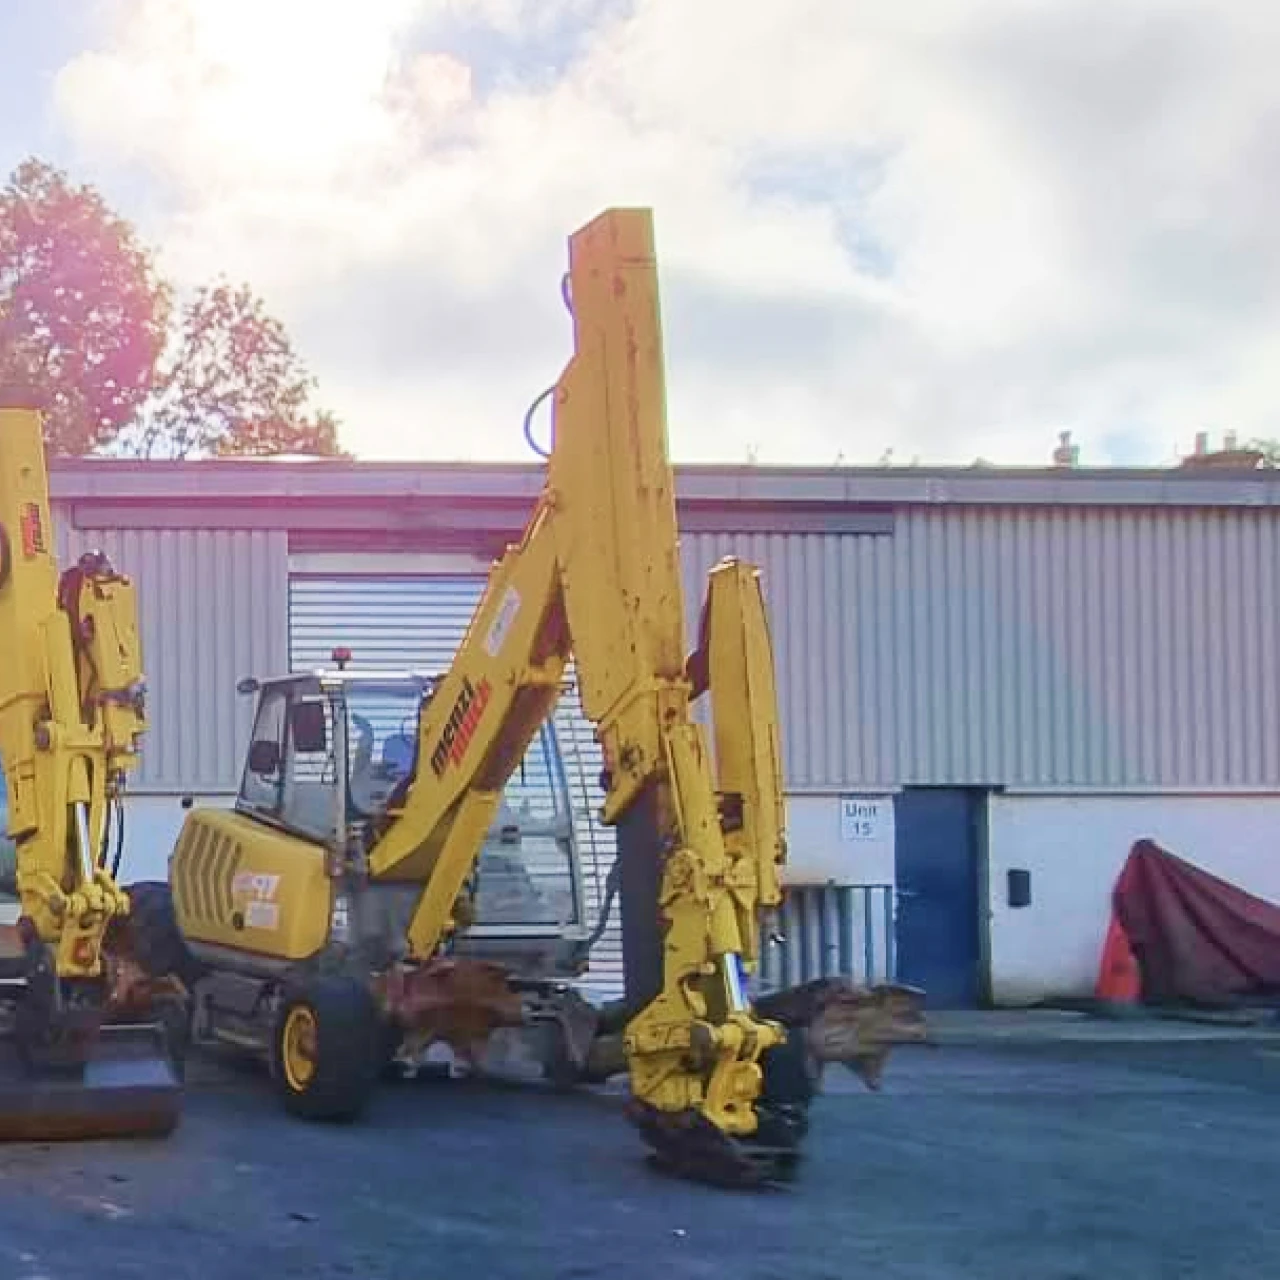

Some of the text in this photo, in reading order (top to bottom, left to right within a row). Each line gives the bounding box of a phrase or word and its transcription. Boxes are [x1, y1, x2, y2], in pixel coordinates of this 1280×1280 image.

[430, 676, 474, 777] menzi
[845, 803, 878, 818] Unit
[853, 821, 872, 837] 15
